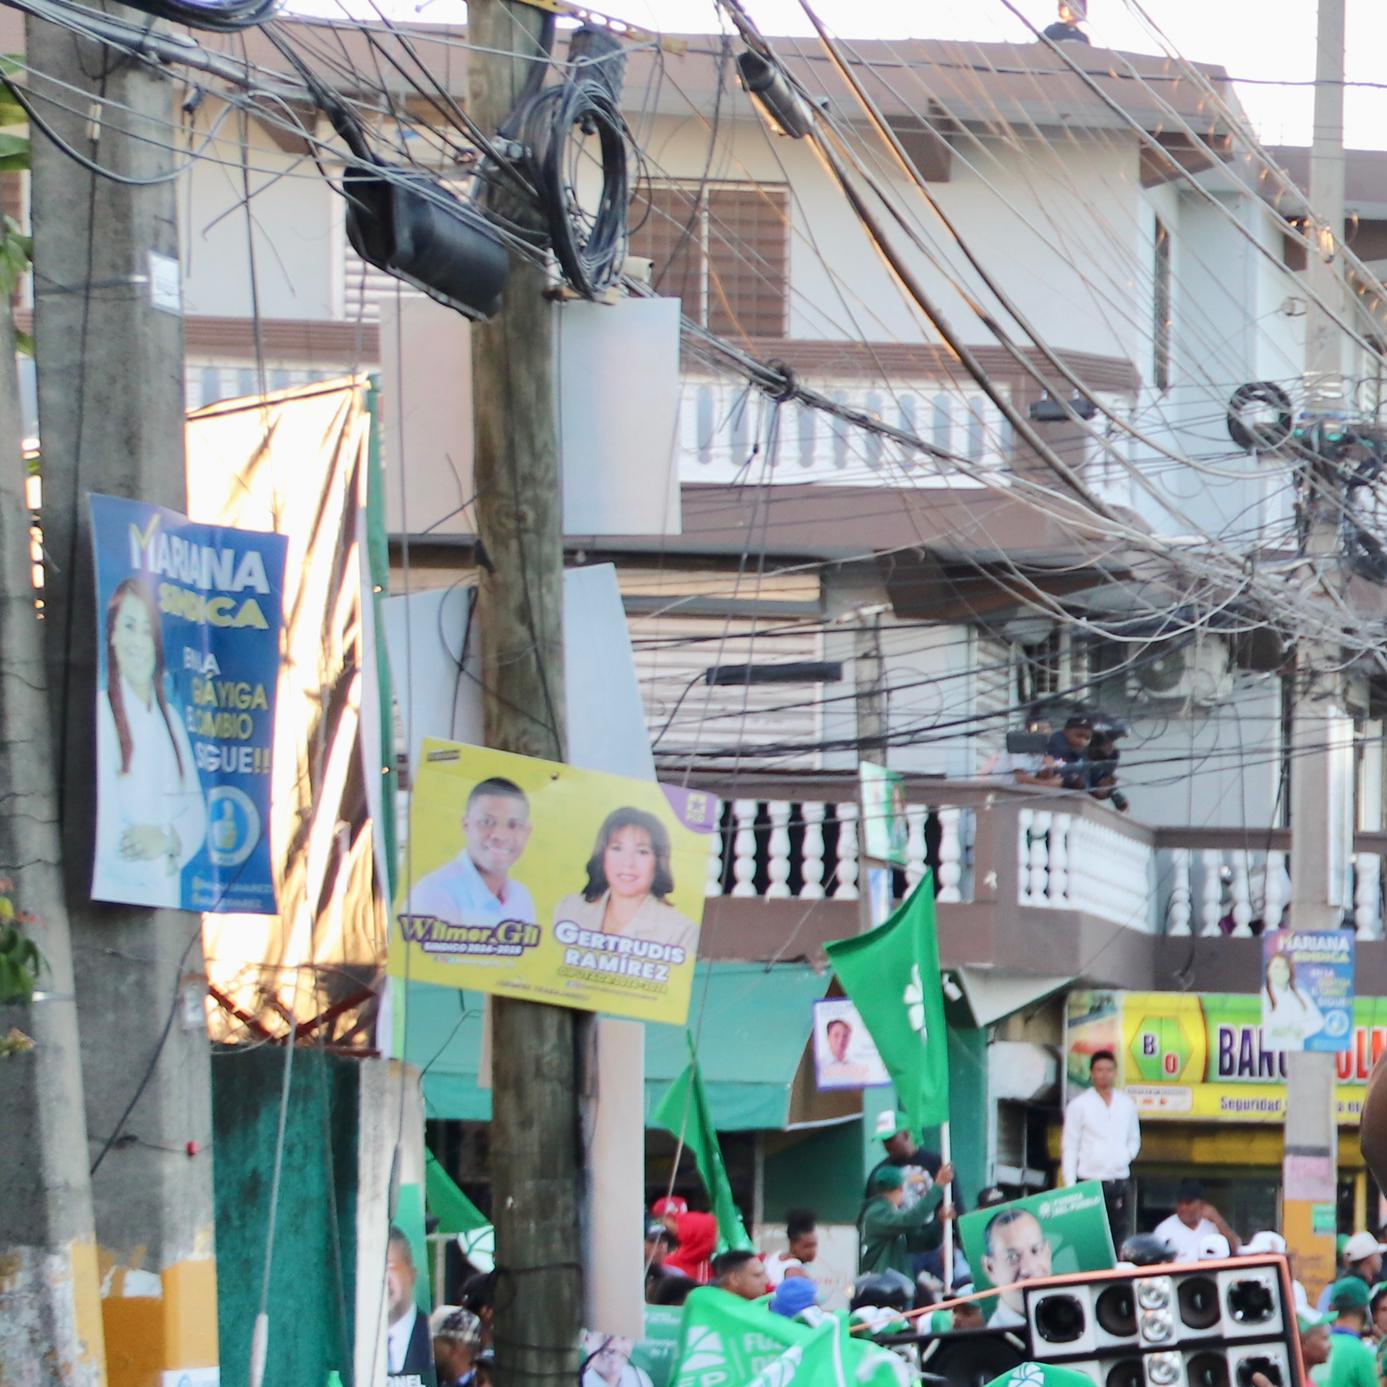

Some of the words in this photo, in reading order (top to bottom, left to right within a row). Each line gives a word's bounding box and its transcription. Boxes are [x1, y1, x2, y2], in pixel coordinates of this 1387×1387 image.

[128, 514, 271, 594] MARIANA
[554, 921, 686, 964] GERTRUDIS
[1278, 932, 1350, 952] MARIANA
[565, 948, 670, 982] RAMÍREZ
[1142, 1033, 1156, 1056] B
